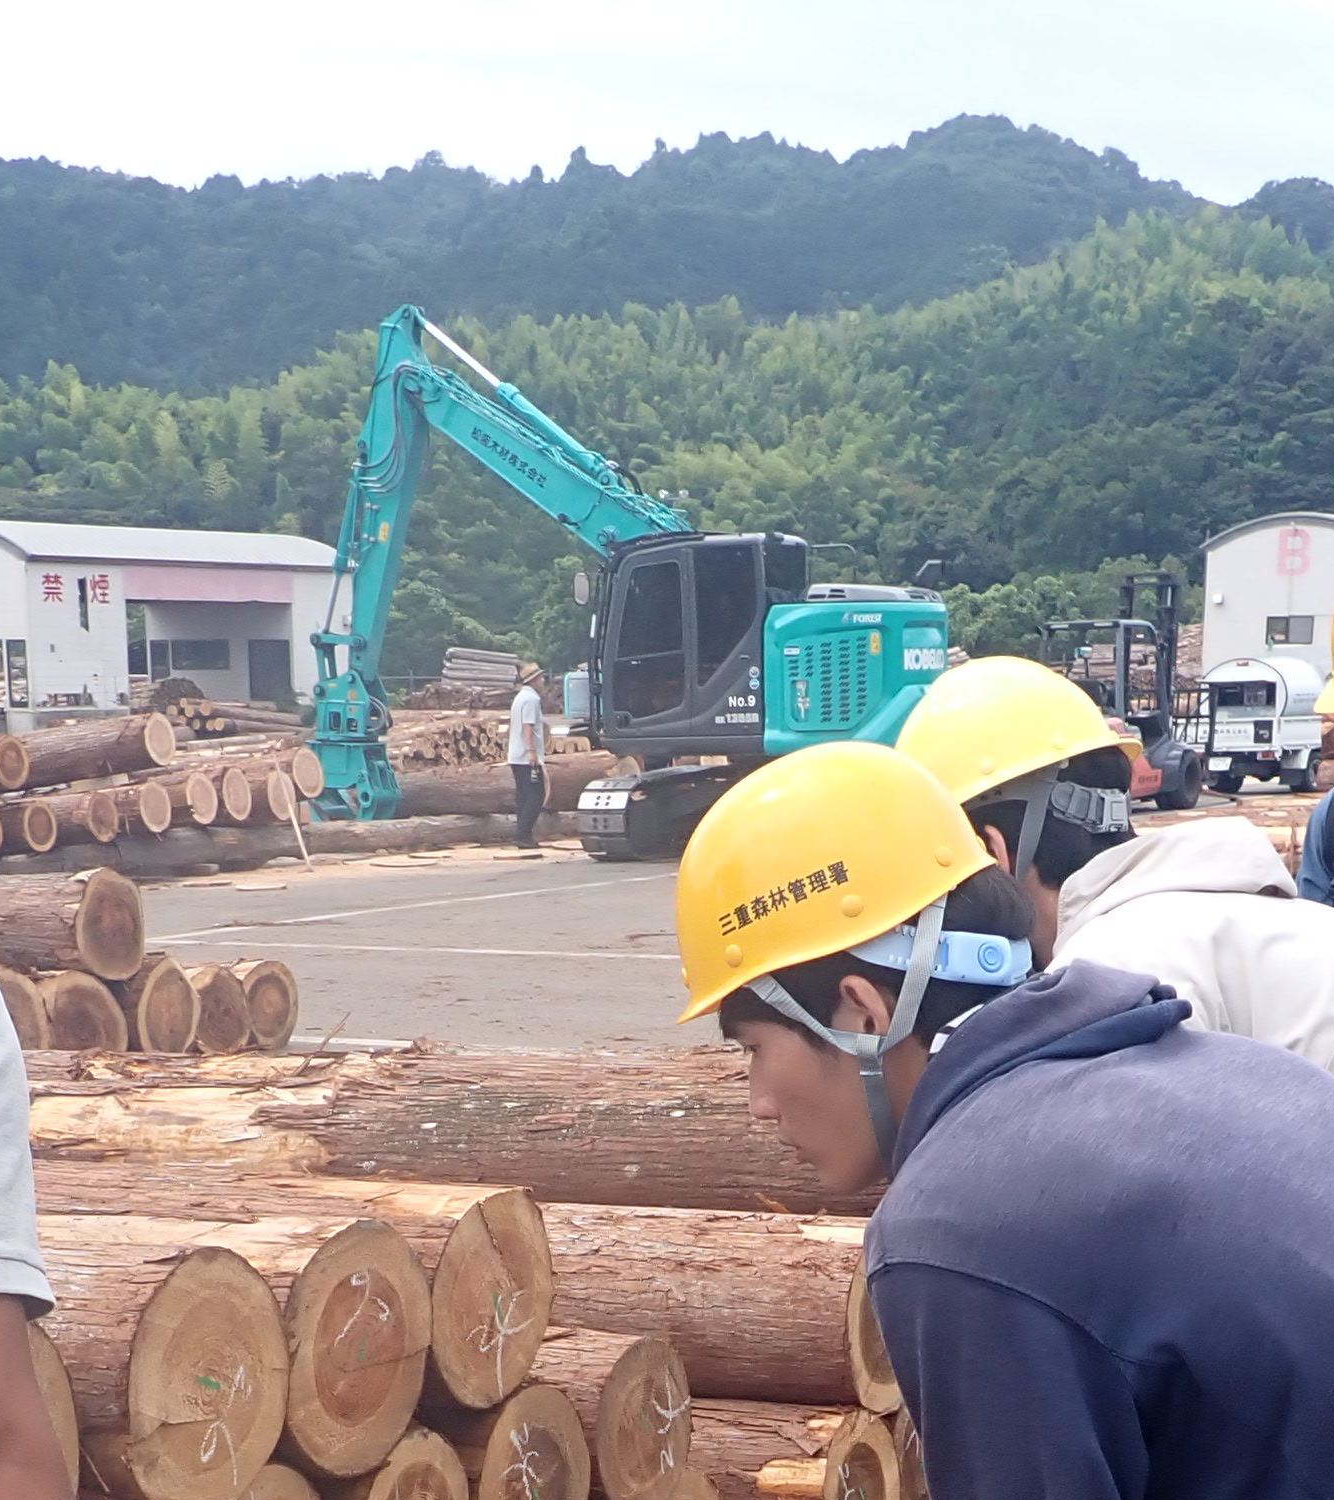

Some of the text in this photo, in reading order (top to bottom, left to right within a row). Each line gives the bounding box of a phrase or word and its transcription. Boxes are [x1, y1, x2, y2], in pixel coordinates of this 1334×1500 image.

[1279, 528, 1310, 576] B
[42, 573, 110, 604] 禁煙
[903, 648, 945, 670] KOBELCO
[728, 695, 756, 707] No.9
[718, 860, 849, 936] 三重森林管理署
